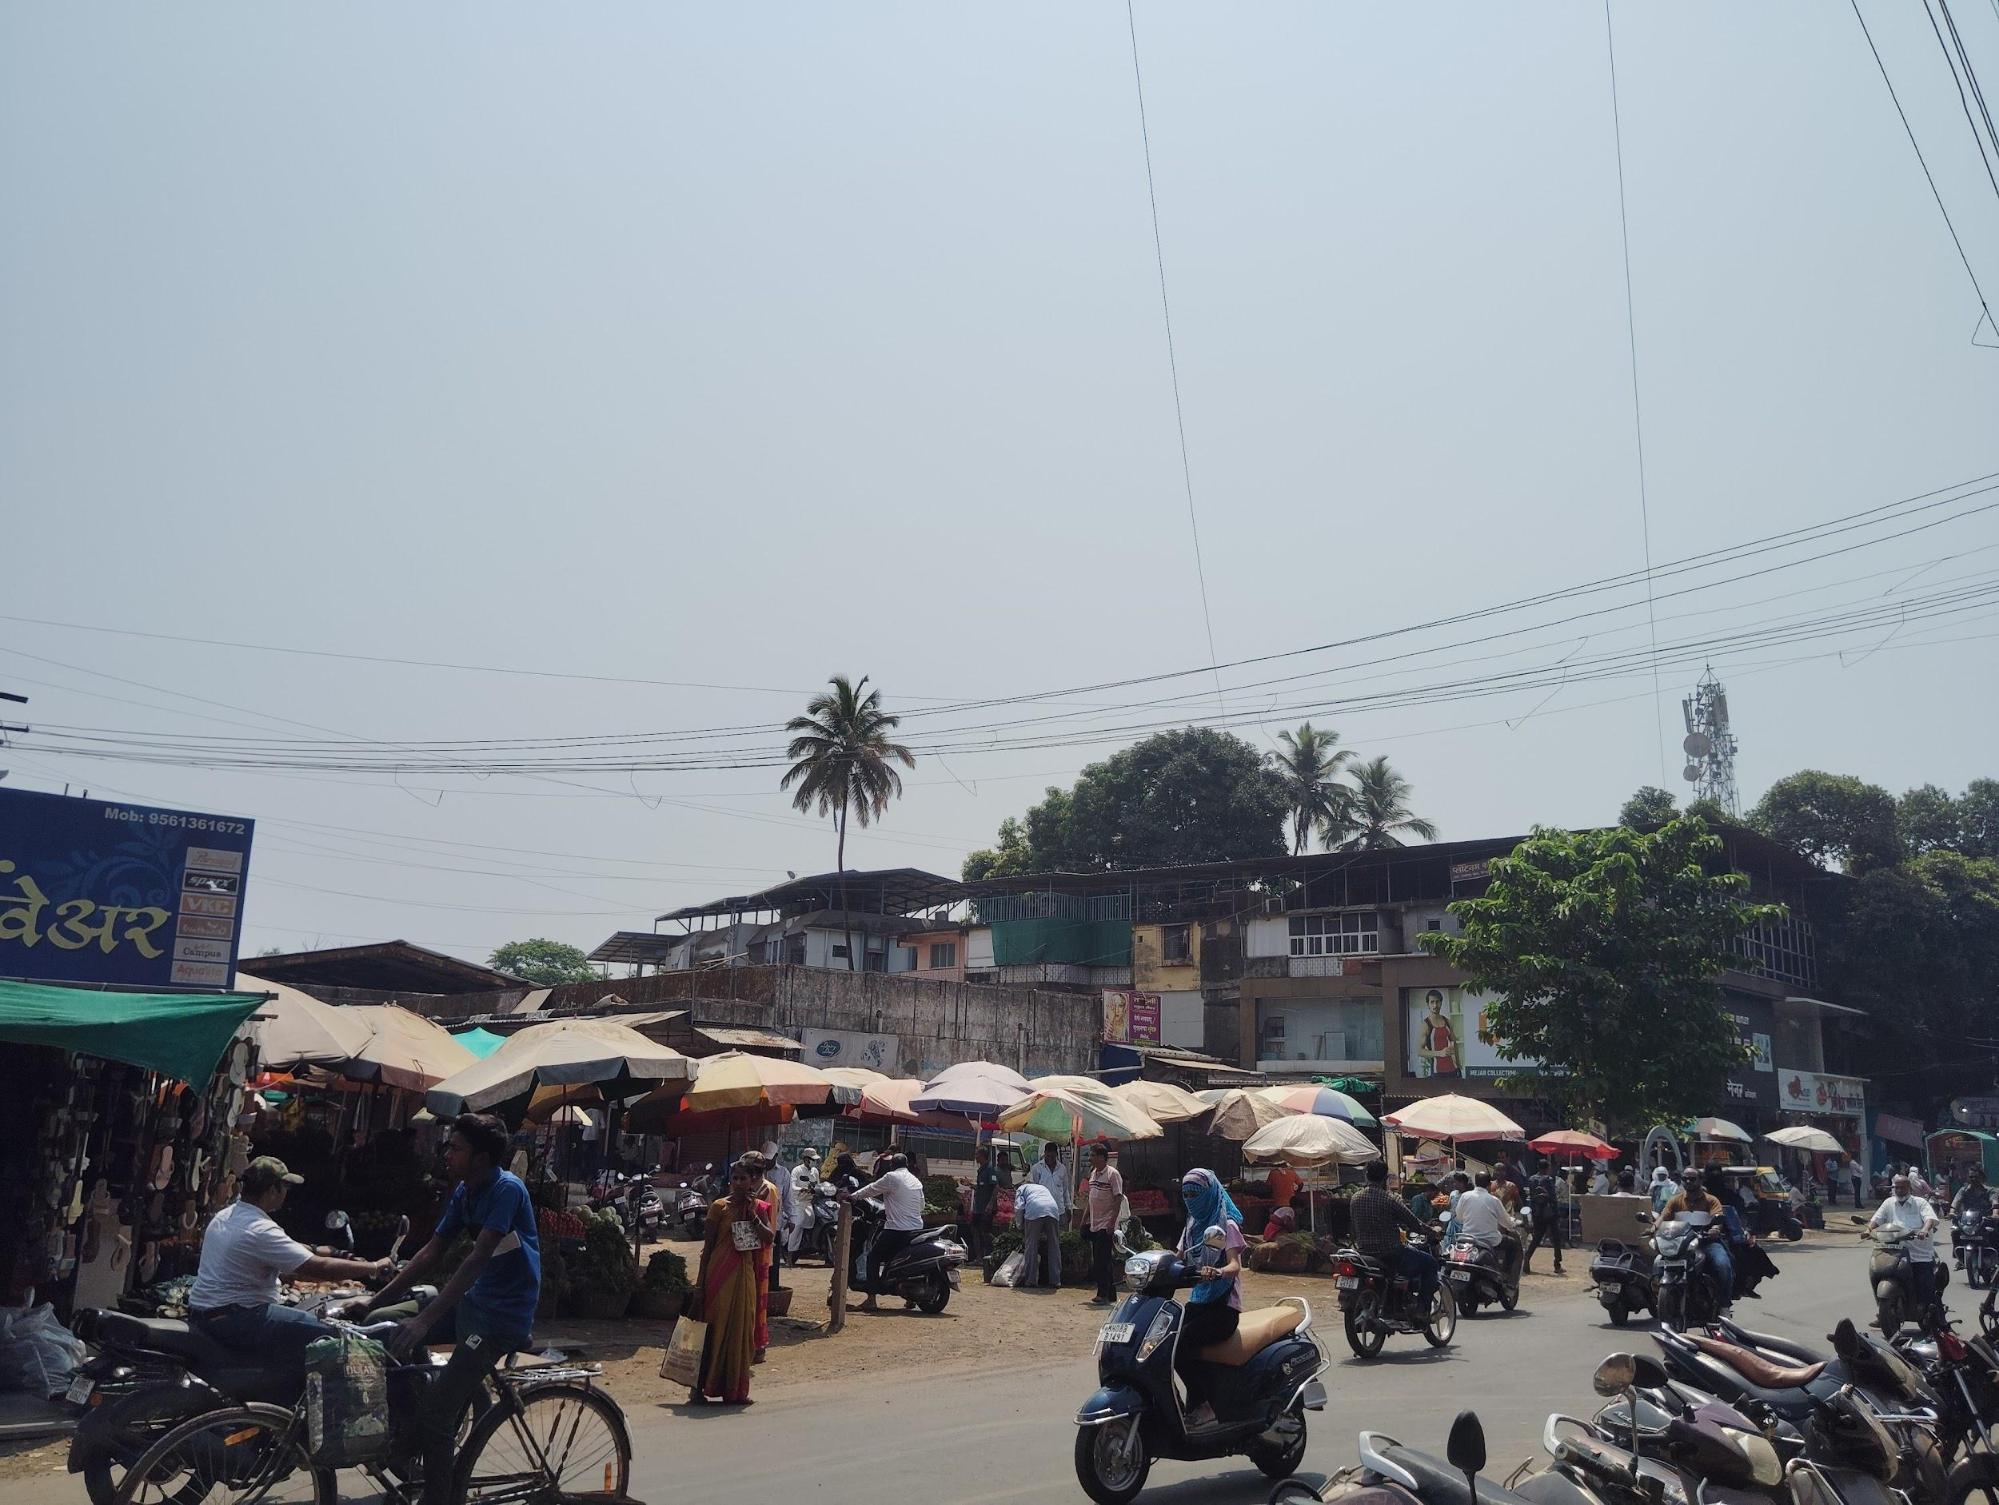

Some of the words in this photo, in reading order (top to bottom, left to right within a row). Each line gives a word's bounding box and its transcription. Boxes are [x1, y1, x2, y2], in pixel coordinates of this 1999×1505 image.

[104, 807, 144, 823] Mob:
[149, 813, 246, 836] 9561361672
[186, 896, 231, 914] VKC
[183, 946, 222, 960] Campus
